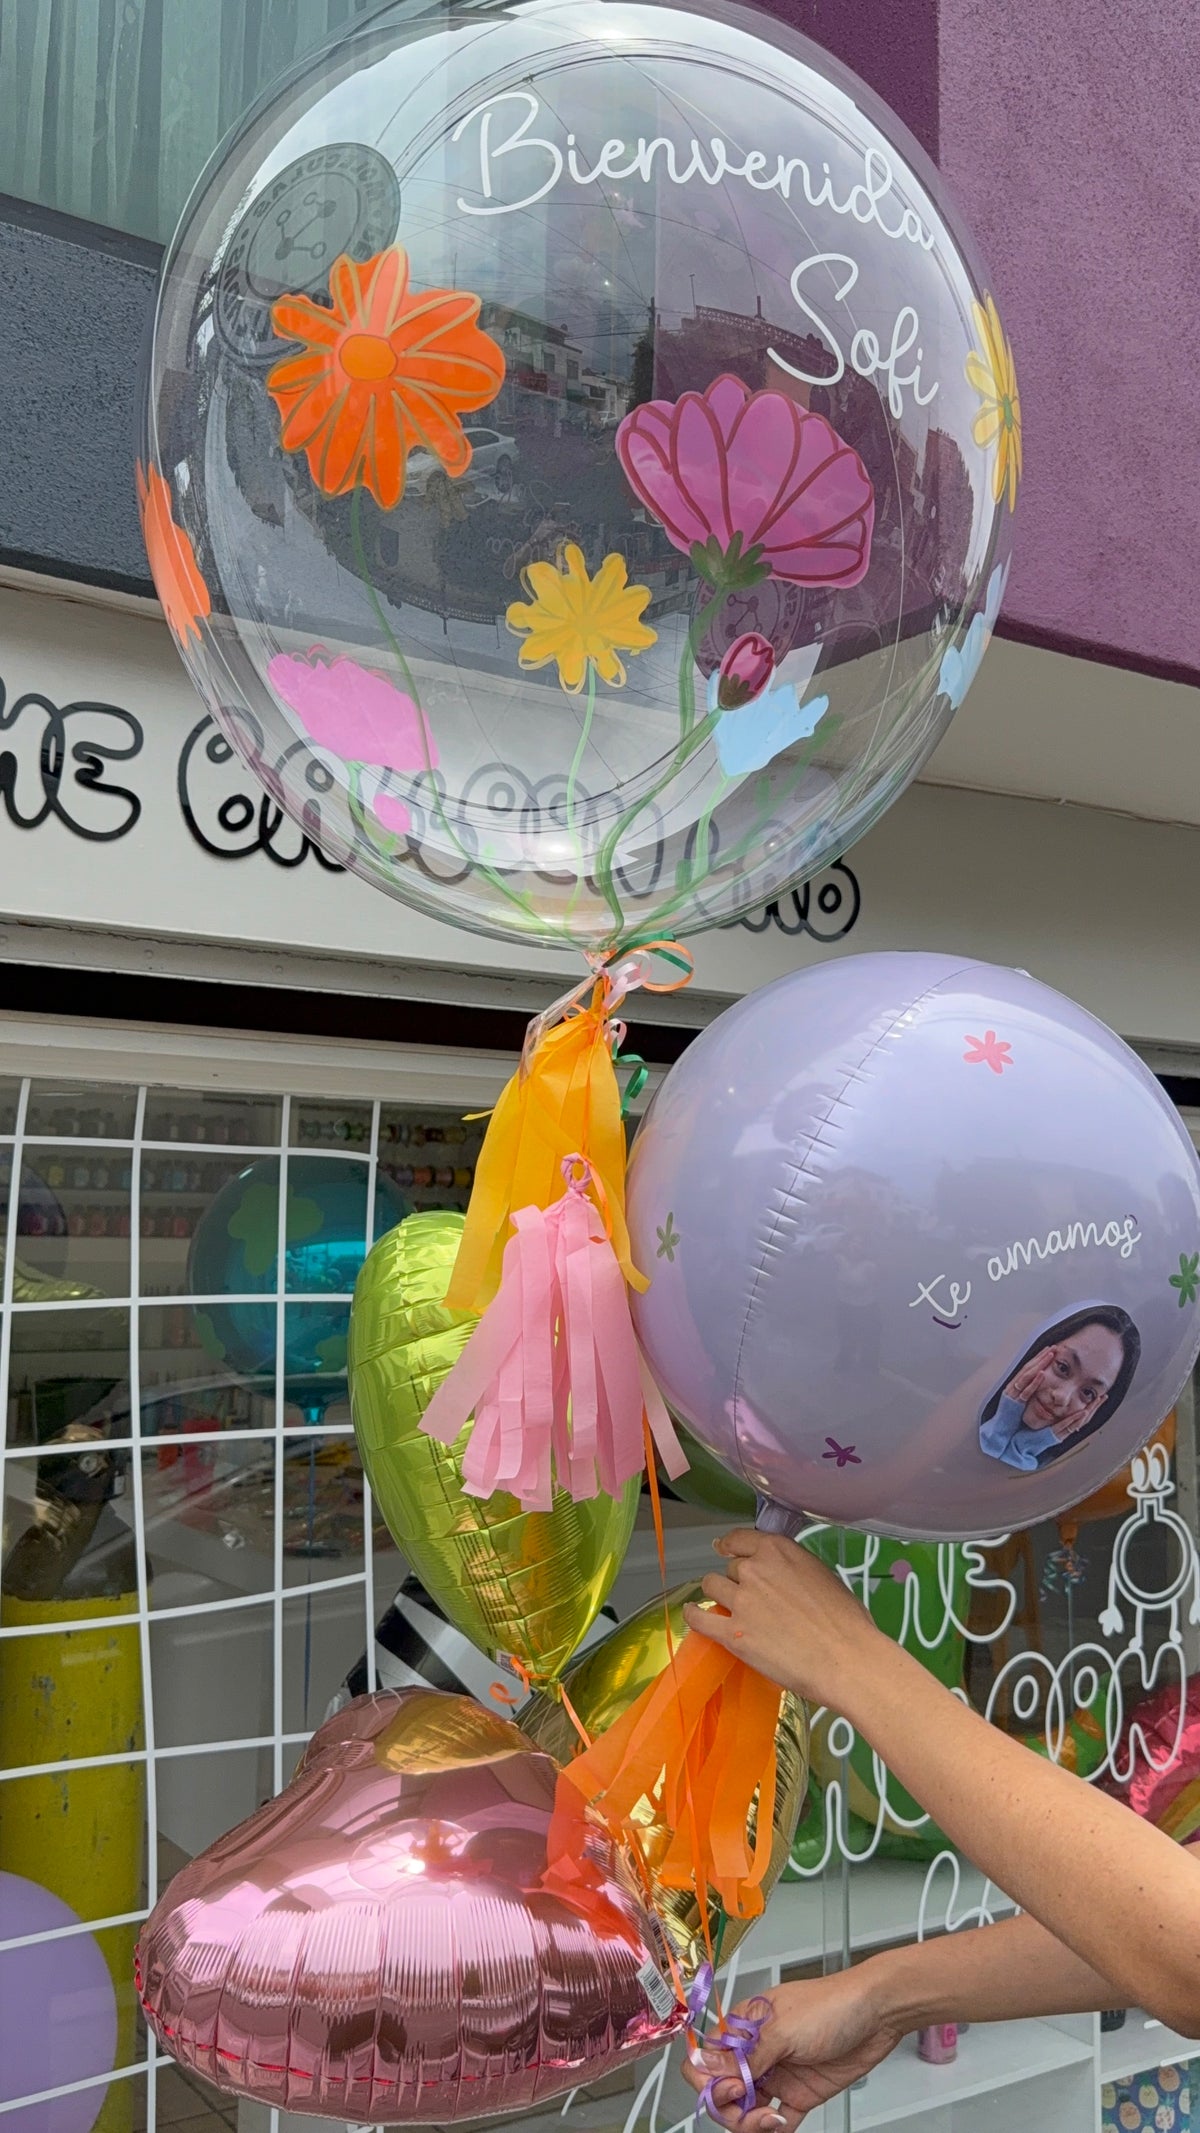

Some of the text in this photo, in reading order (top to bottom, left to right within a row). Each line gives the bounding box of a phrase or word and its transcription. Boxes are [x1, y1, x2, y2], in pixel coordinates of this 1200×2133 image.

[451, 90, 936, 251] Bienvenida
[766, 252, 940, 420] Sofi
[908, 1217, 1142, 1318] te amamos
